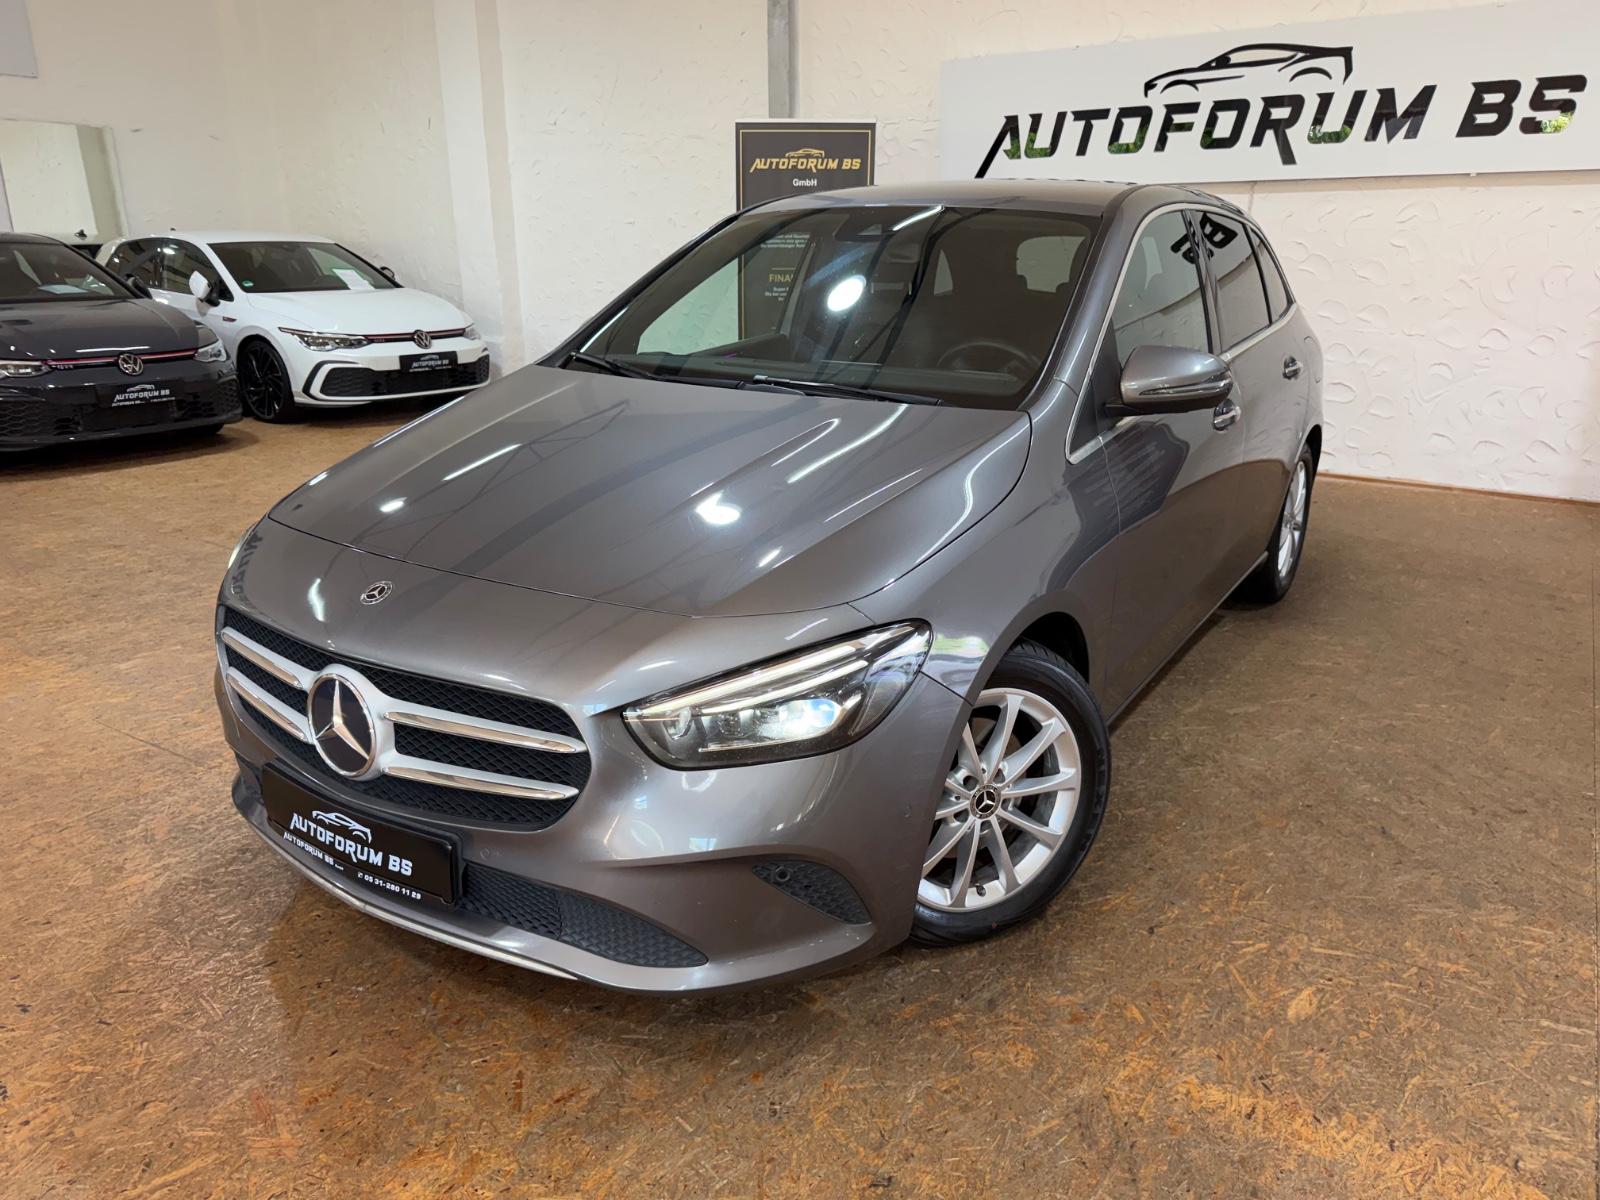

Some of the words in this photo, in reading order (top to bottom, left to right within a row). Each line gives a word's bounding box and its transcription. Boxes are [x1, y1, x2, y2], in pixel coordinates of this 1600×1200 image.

[974, 84, 1437, 179] AUTOFORUM
[1456, 74, 1588, 138] BS
[749, 158, 838, 173] AUTOFORUM
[841, 158, 862, 170] BS
[792, 178, 818, 187] GmbH
[768, 273, 794, 283] FINA
[114, 390, 159, 402] AUTOFORUM
[283, 831, 323, 860] AUTOFORUM
[290, 813, 383, 867] AUTOFORUM
[388, 854, 413, 877] BS
